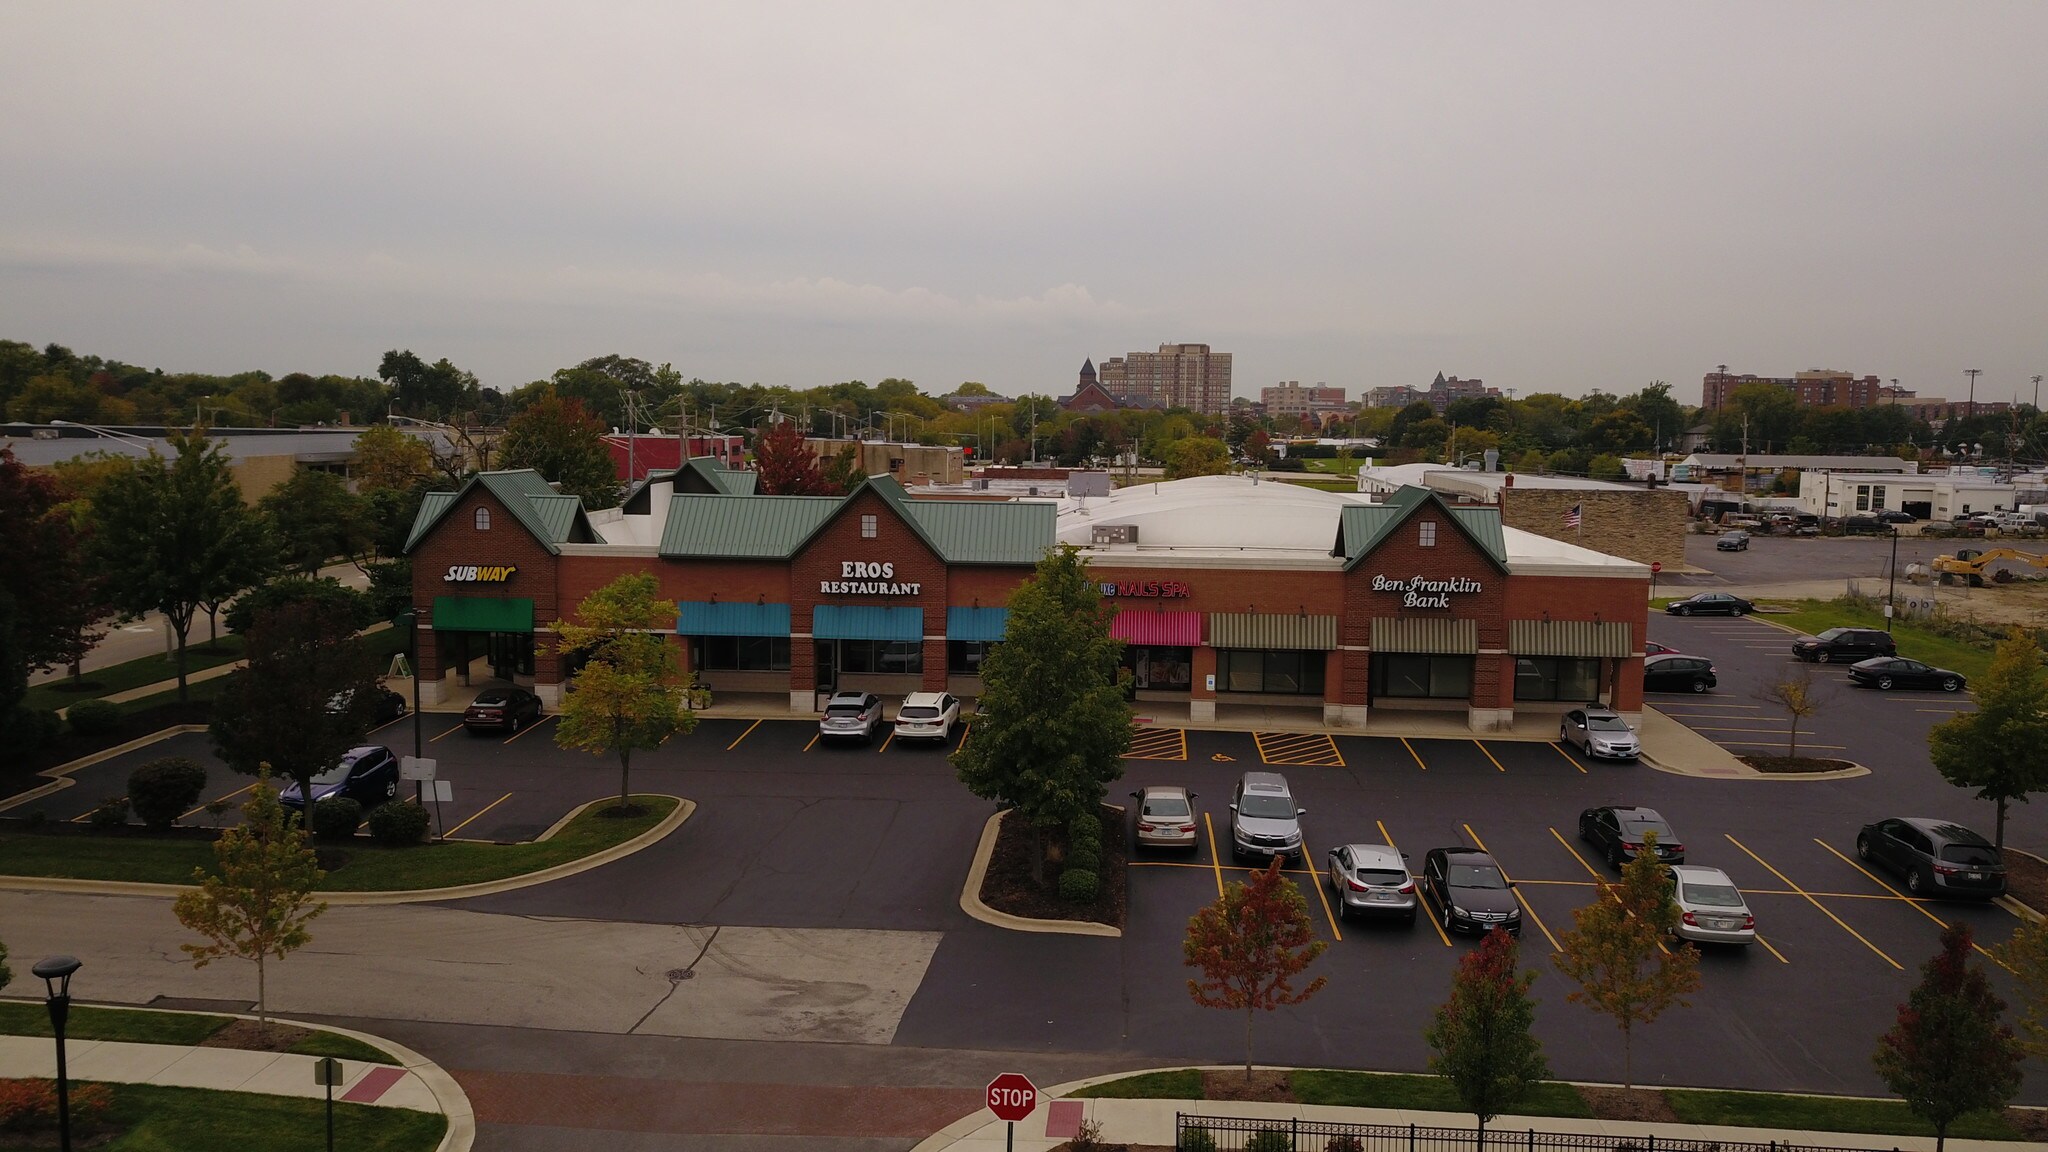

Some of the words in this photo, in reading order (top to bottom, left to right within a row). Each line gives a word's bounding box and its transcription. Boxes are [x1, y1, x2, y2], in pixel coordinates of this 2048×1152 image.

[444, 564, 517, 582] SUBWAY
[841, 561, 894, 579] EROS
[820, 580, 921, 596] RESTAURANT
[1117, 579, 1159, 597] NAILS
[1161, 581, 1190, 598] SPA
[1372, 574, 1404, 592] Ben
[1405, 574, 1482, 593] Franklin
[1403, 591, 1450, 608] Bank
[990, 1087, 1034, 1107] STOP
